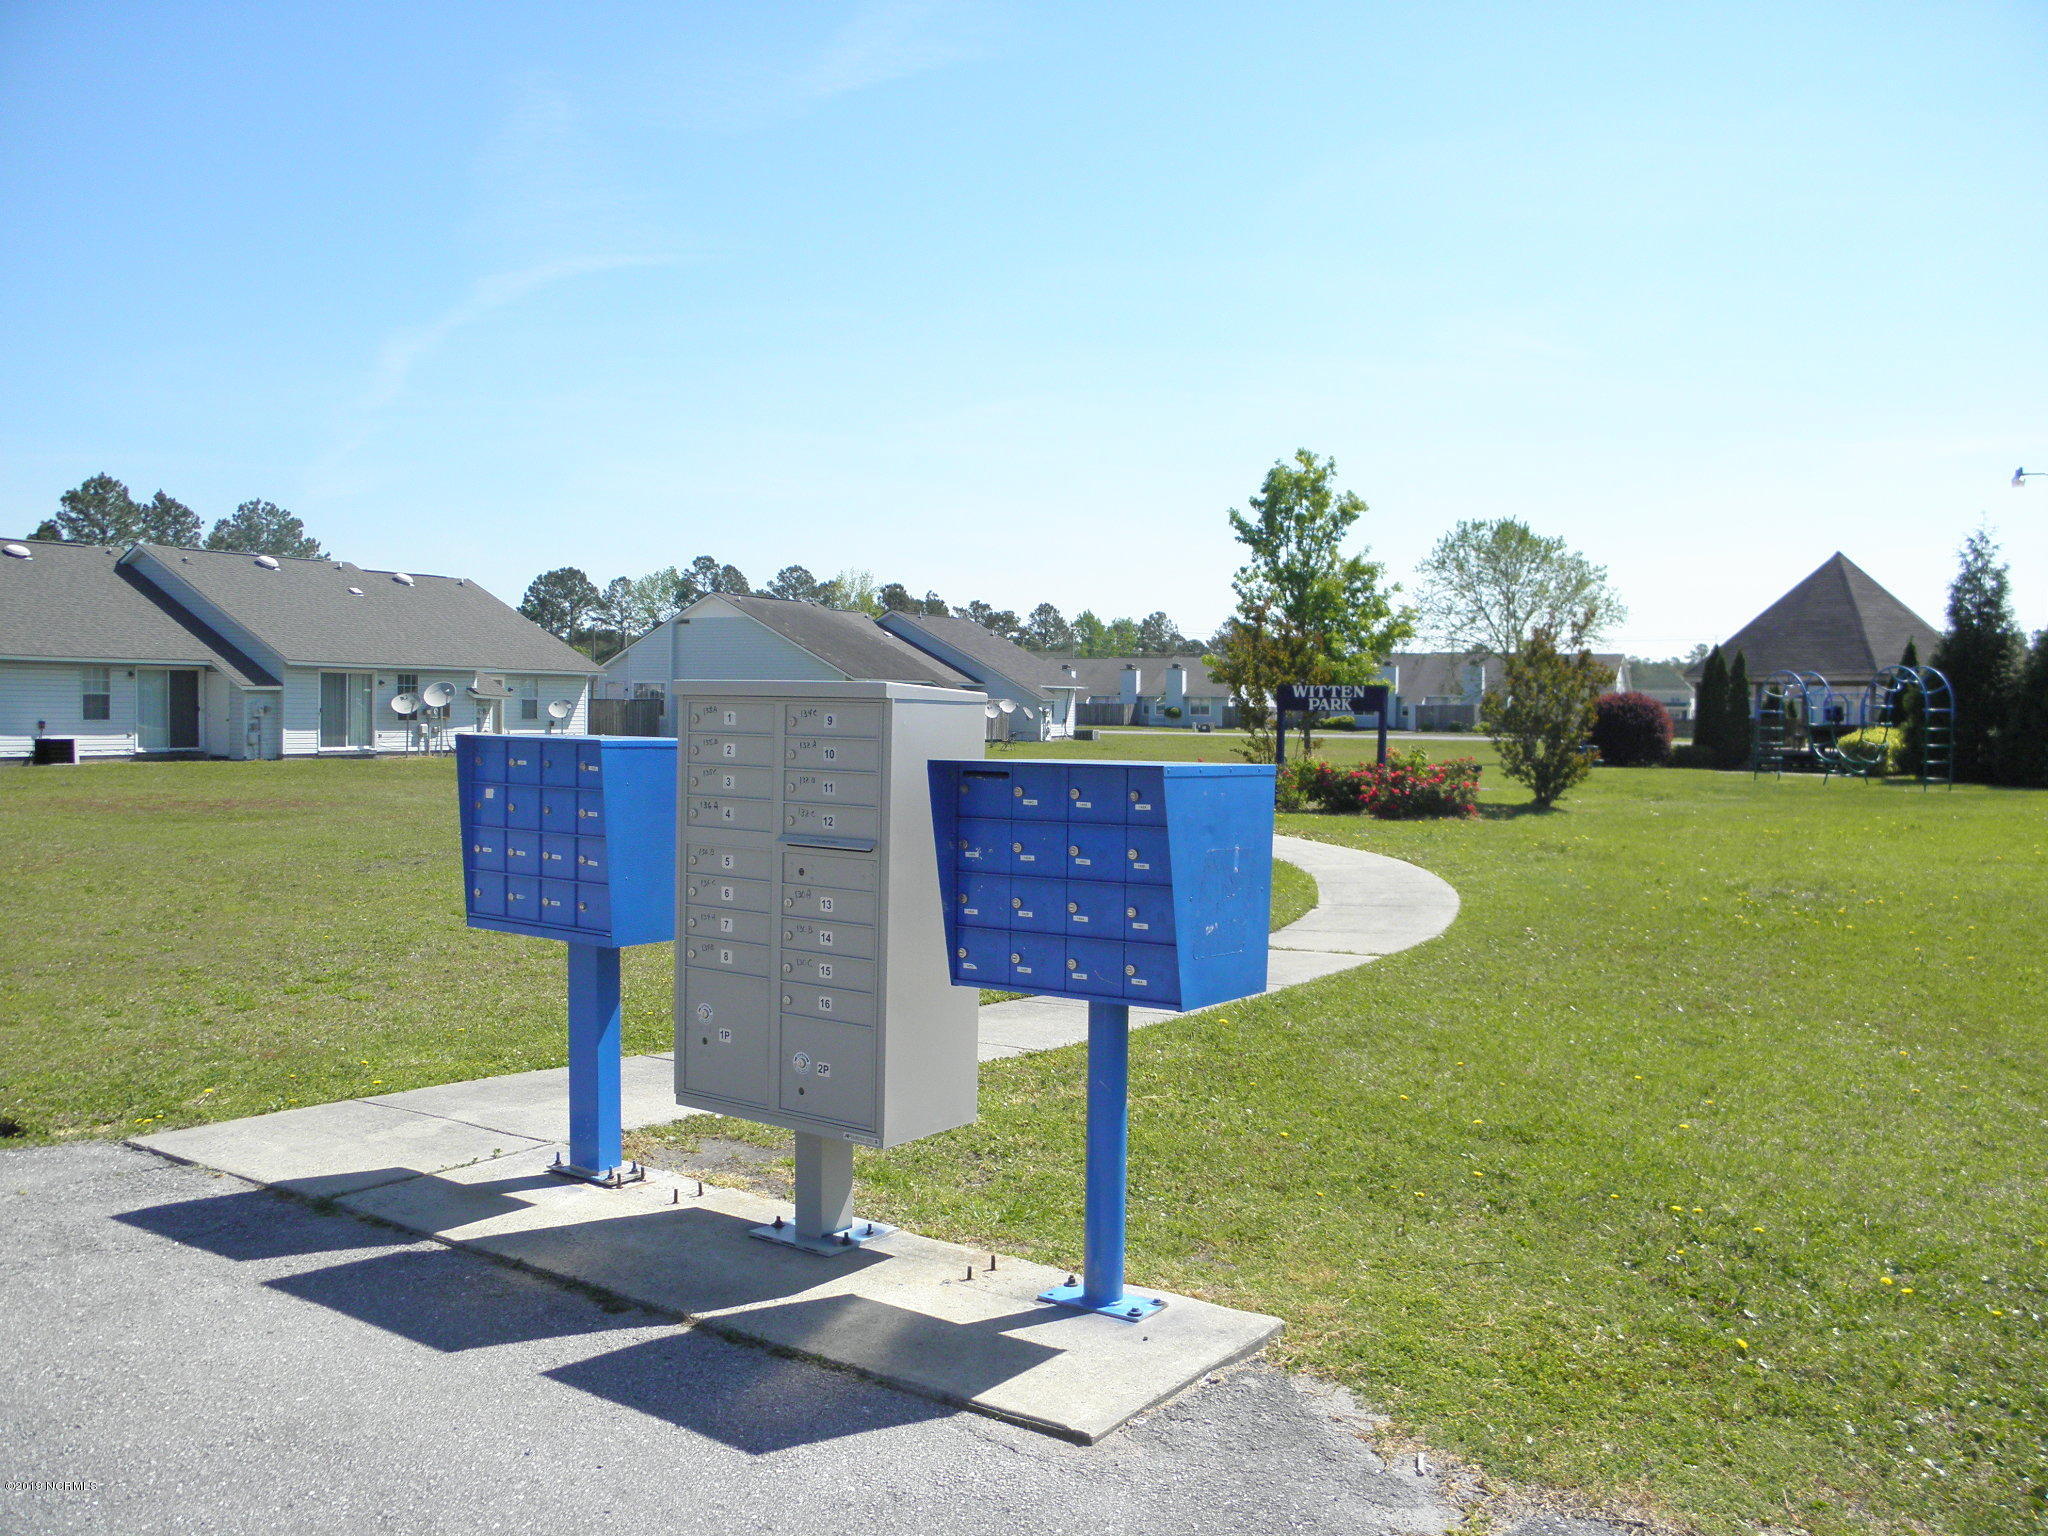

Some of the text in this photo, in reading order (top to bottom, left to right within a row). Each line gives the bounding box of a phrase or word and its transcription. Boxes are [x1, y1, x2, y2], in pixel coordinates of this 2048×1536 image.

[1292, 685, 1365, 698] WITTEN
[1308, 698, 1352, 711] PARK
[827, 716, 833, 725] 9
[726, 746, 732, 755] 2
[825, 750, 835, 759] 10
[726, 777, 731, 786] 3
[824, 783, 833, 792] 11
[725, 809, 731, 818] 4
[823, 817, 833, 827] 12
[724, 857, 730, 867] 5
[724, 889, 730, 898] 6
[821, 900, 832, 909] 13
[724, 921, 729, 930] 7
[821, 933, 831, 943] 14
[723, 952, 729, 961] 8
[820, 966, 831, 976] 15
[820, 998, 831, 1008] 16
[720, 1030, 730, 1040] 1P
[817, 1063, 829, 1074] 2P
